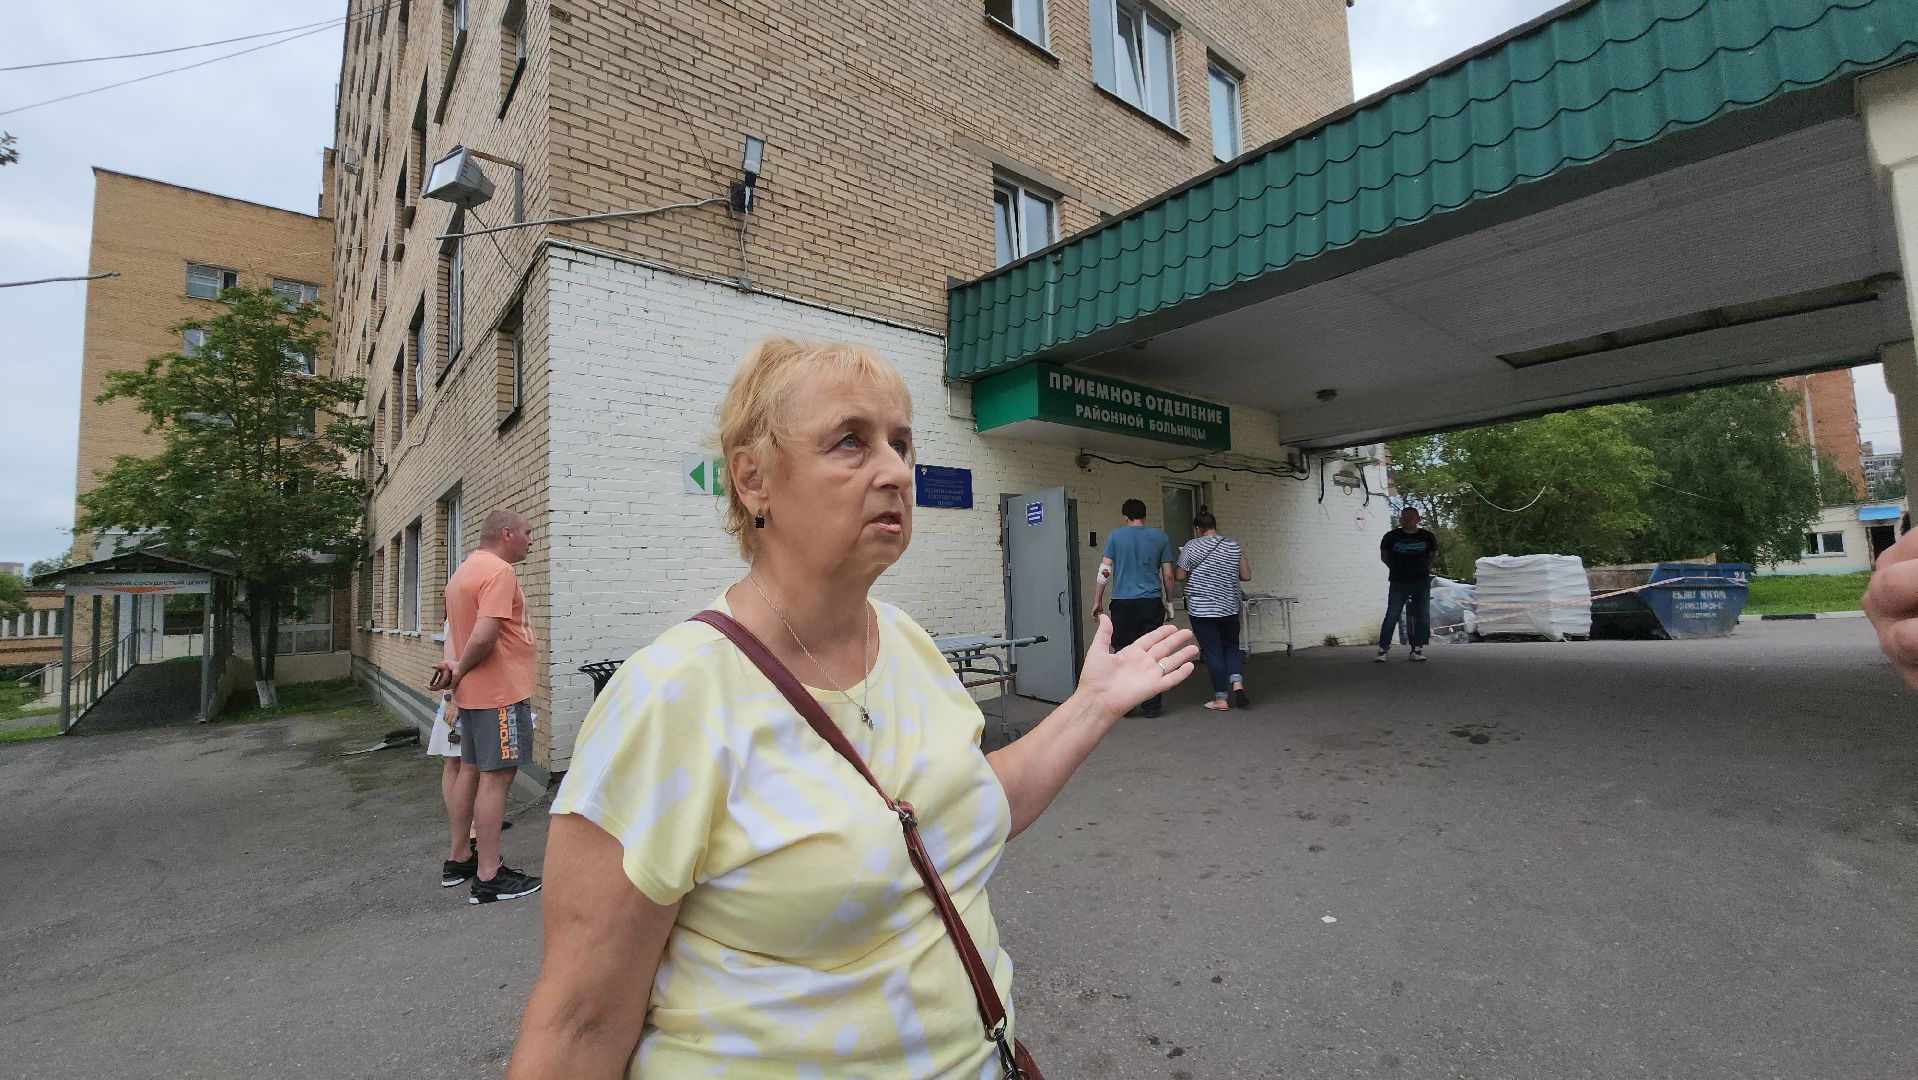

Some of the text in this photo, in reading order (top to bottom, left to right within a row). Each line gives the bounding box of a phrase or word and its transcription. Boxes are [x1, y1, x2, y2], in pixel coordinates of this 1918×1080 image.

[1049, 371, 1223, 425] ПРИЕМНОЕ ОТДЕЛЕНИЕ
[1075, 403, 1206, 441] РАЙОННОЙ БОЛЬНИЦЫ
[498, 707, 510, 759] RMOUR
[507, 704, 518, 745] NDER
